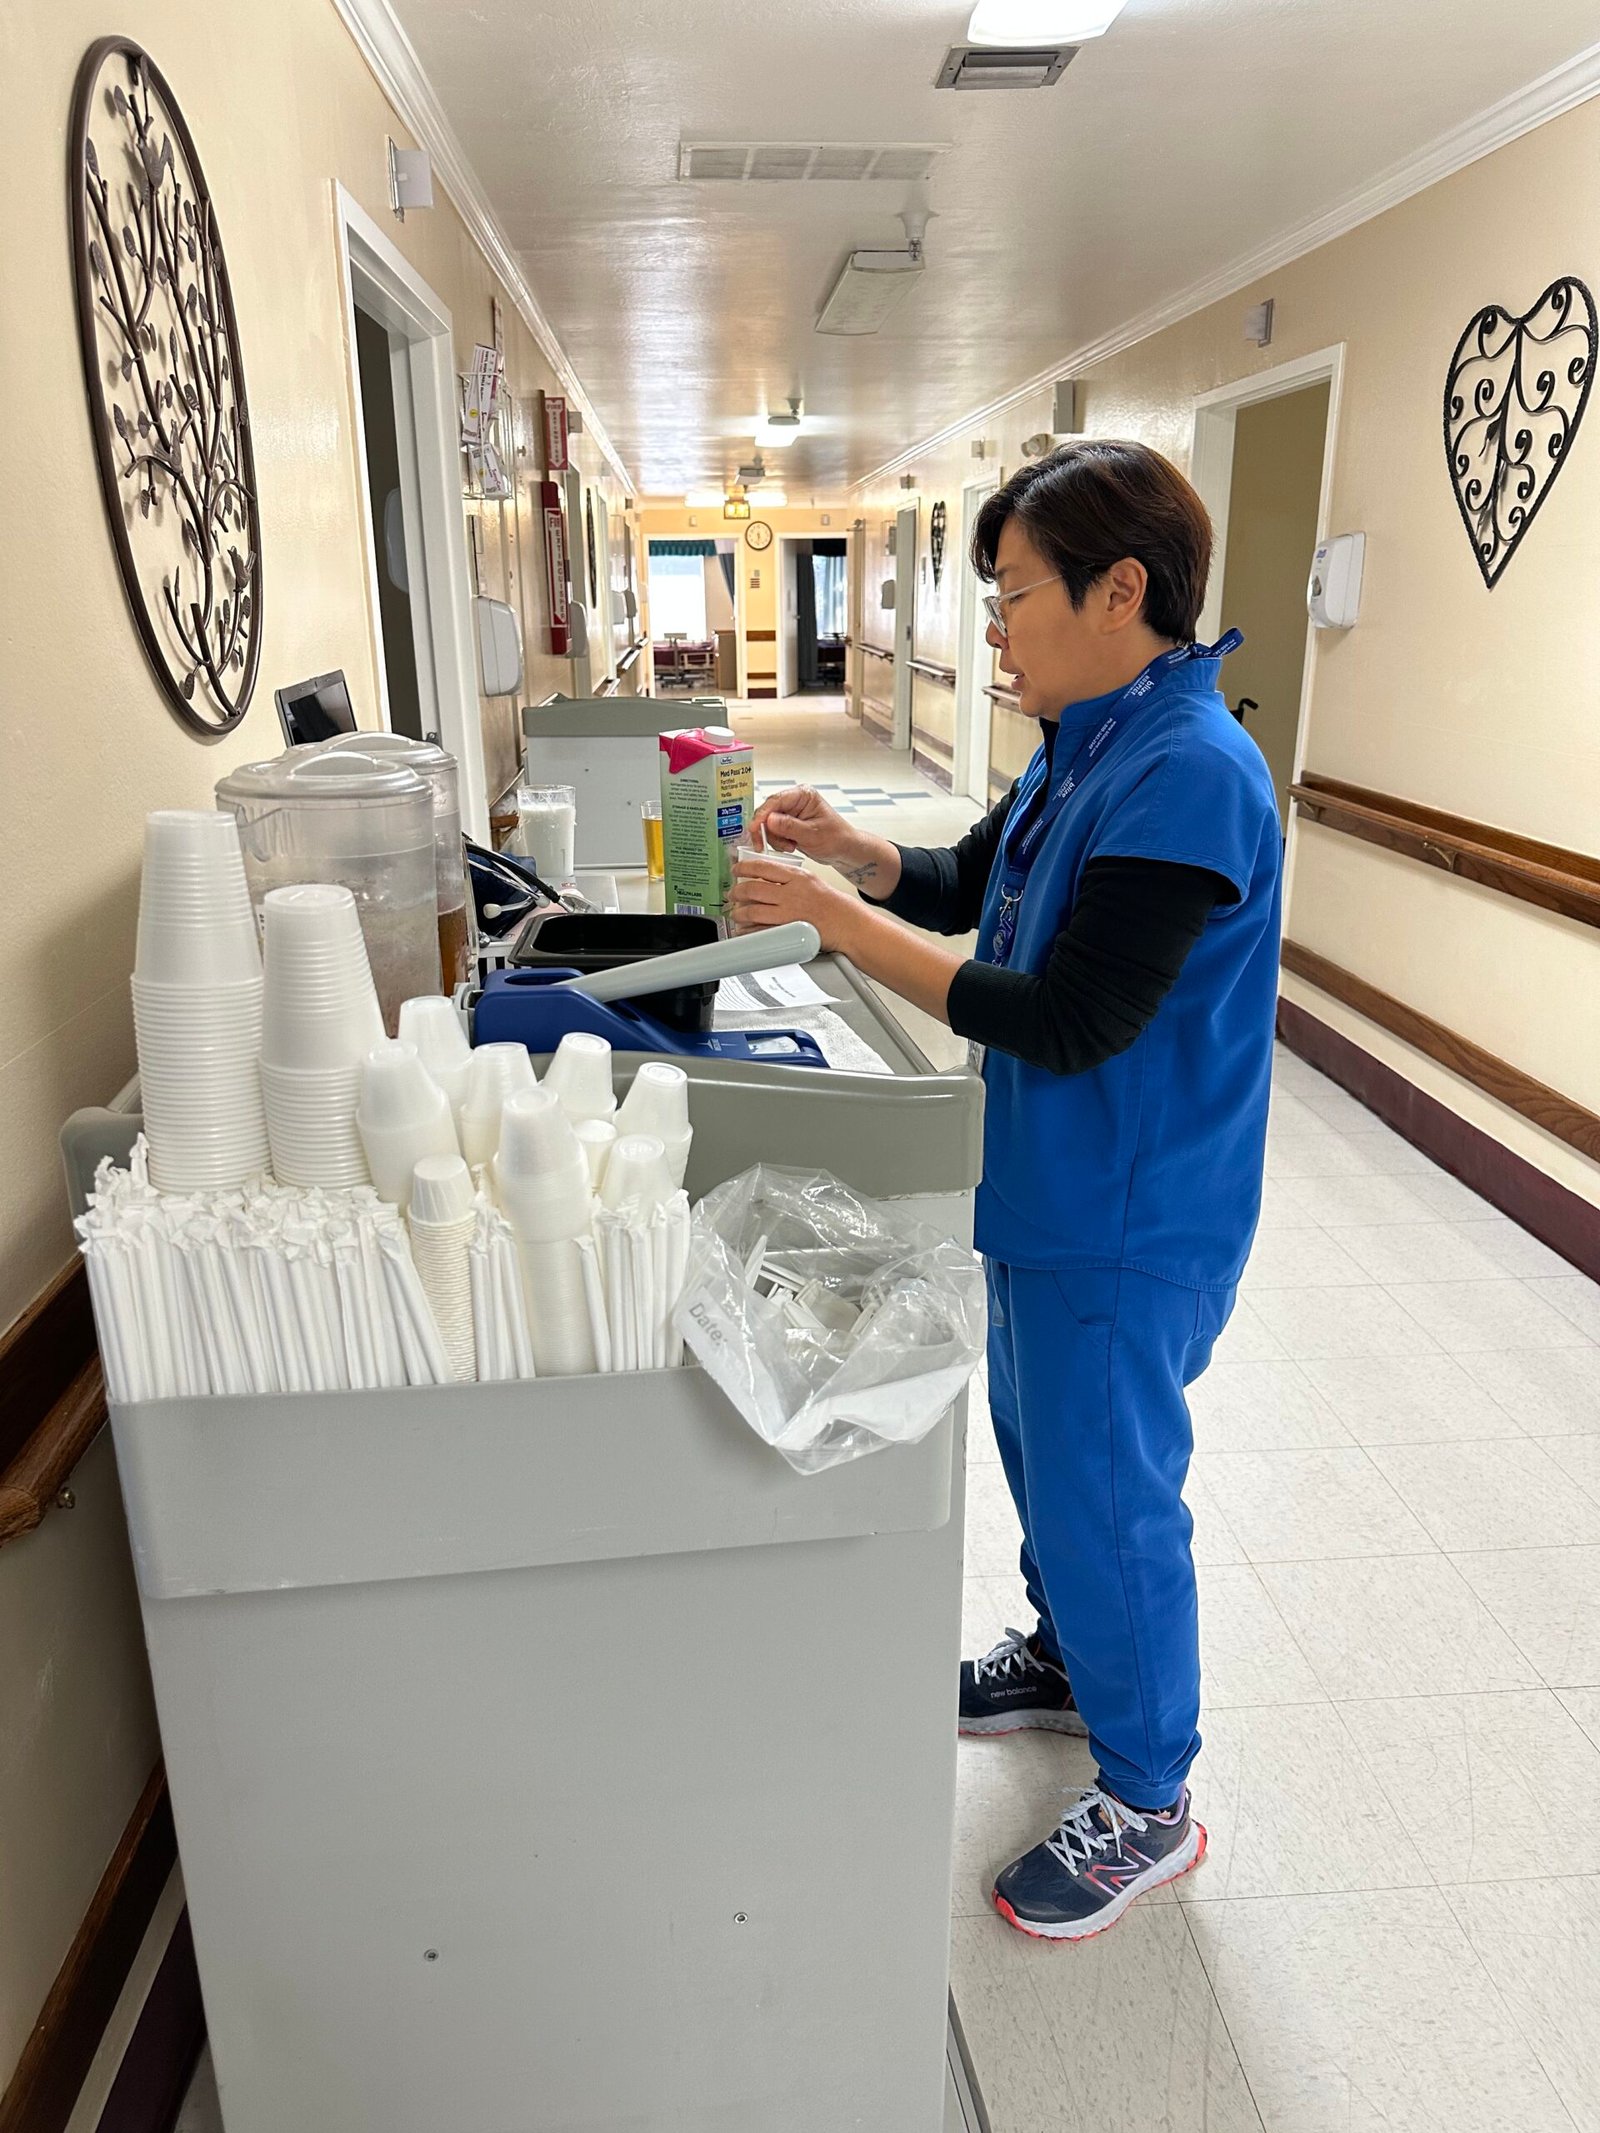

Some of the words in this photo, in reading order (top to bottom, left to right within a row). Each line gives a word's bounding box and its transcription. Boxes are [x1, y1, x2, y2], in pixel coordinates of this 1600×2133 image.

[556, 529, 566, 618] EXTINGUISHER
[720, 769, 730, 777] Med
[689, 1302, 728, 1346] Date:
[991, 1690, 1006, 1698] new
[1006, 1686, 1037, 1696] balance
